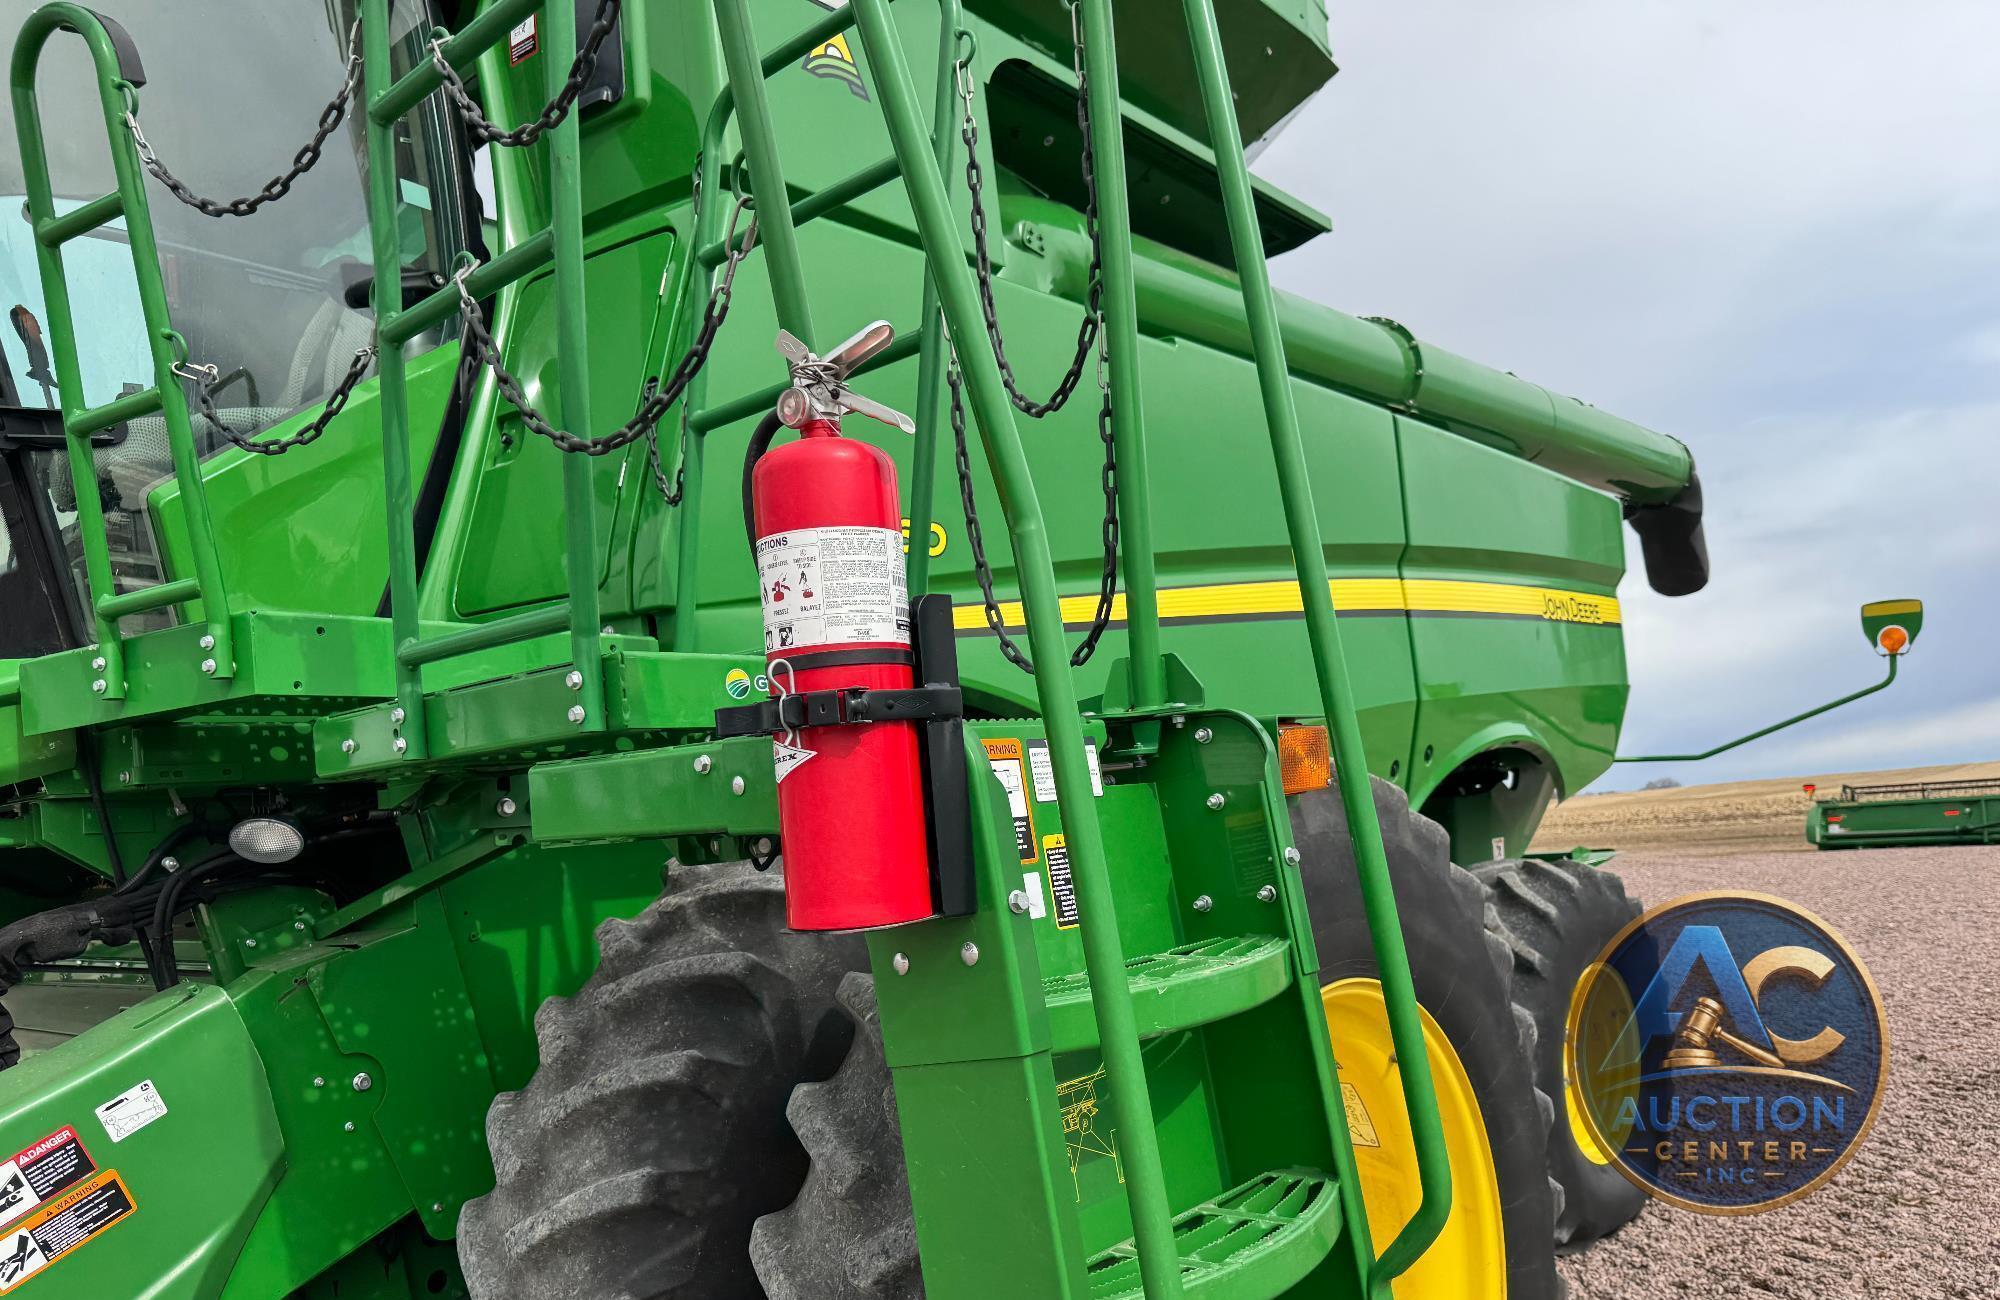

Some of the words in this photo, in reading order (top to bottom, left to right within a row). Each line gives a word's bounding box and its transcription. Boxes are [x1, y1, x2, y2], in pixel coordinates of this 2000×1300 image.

[1542, 593, 1570, 619] JOHN
[1569, 597, 1602, 622] DEERE
[984, 745, 1018, 754] RNING
[27, 1130, 72, 1159] DANGER
[55, 1181, 100, 1210] WARNING
